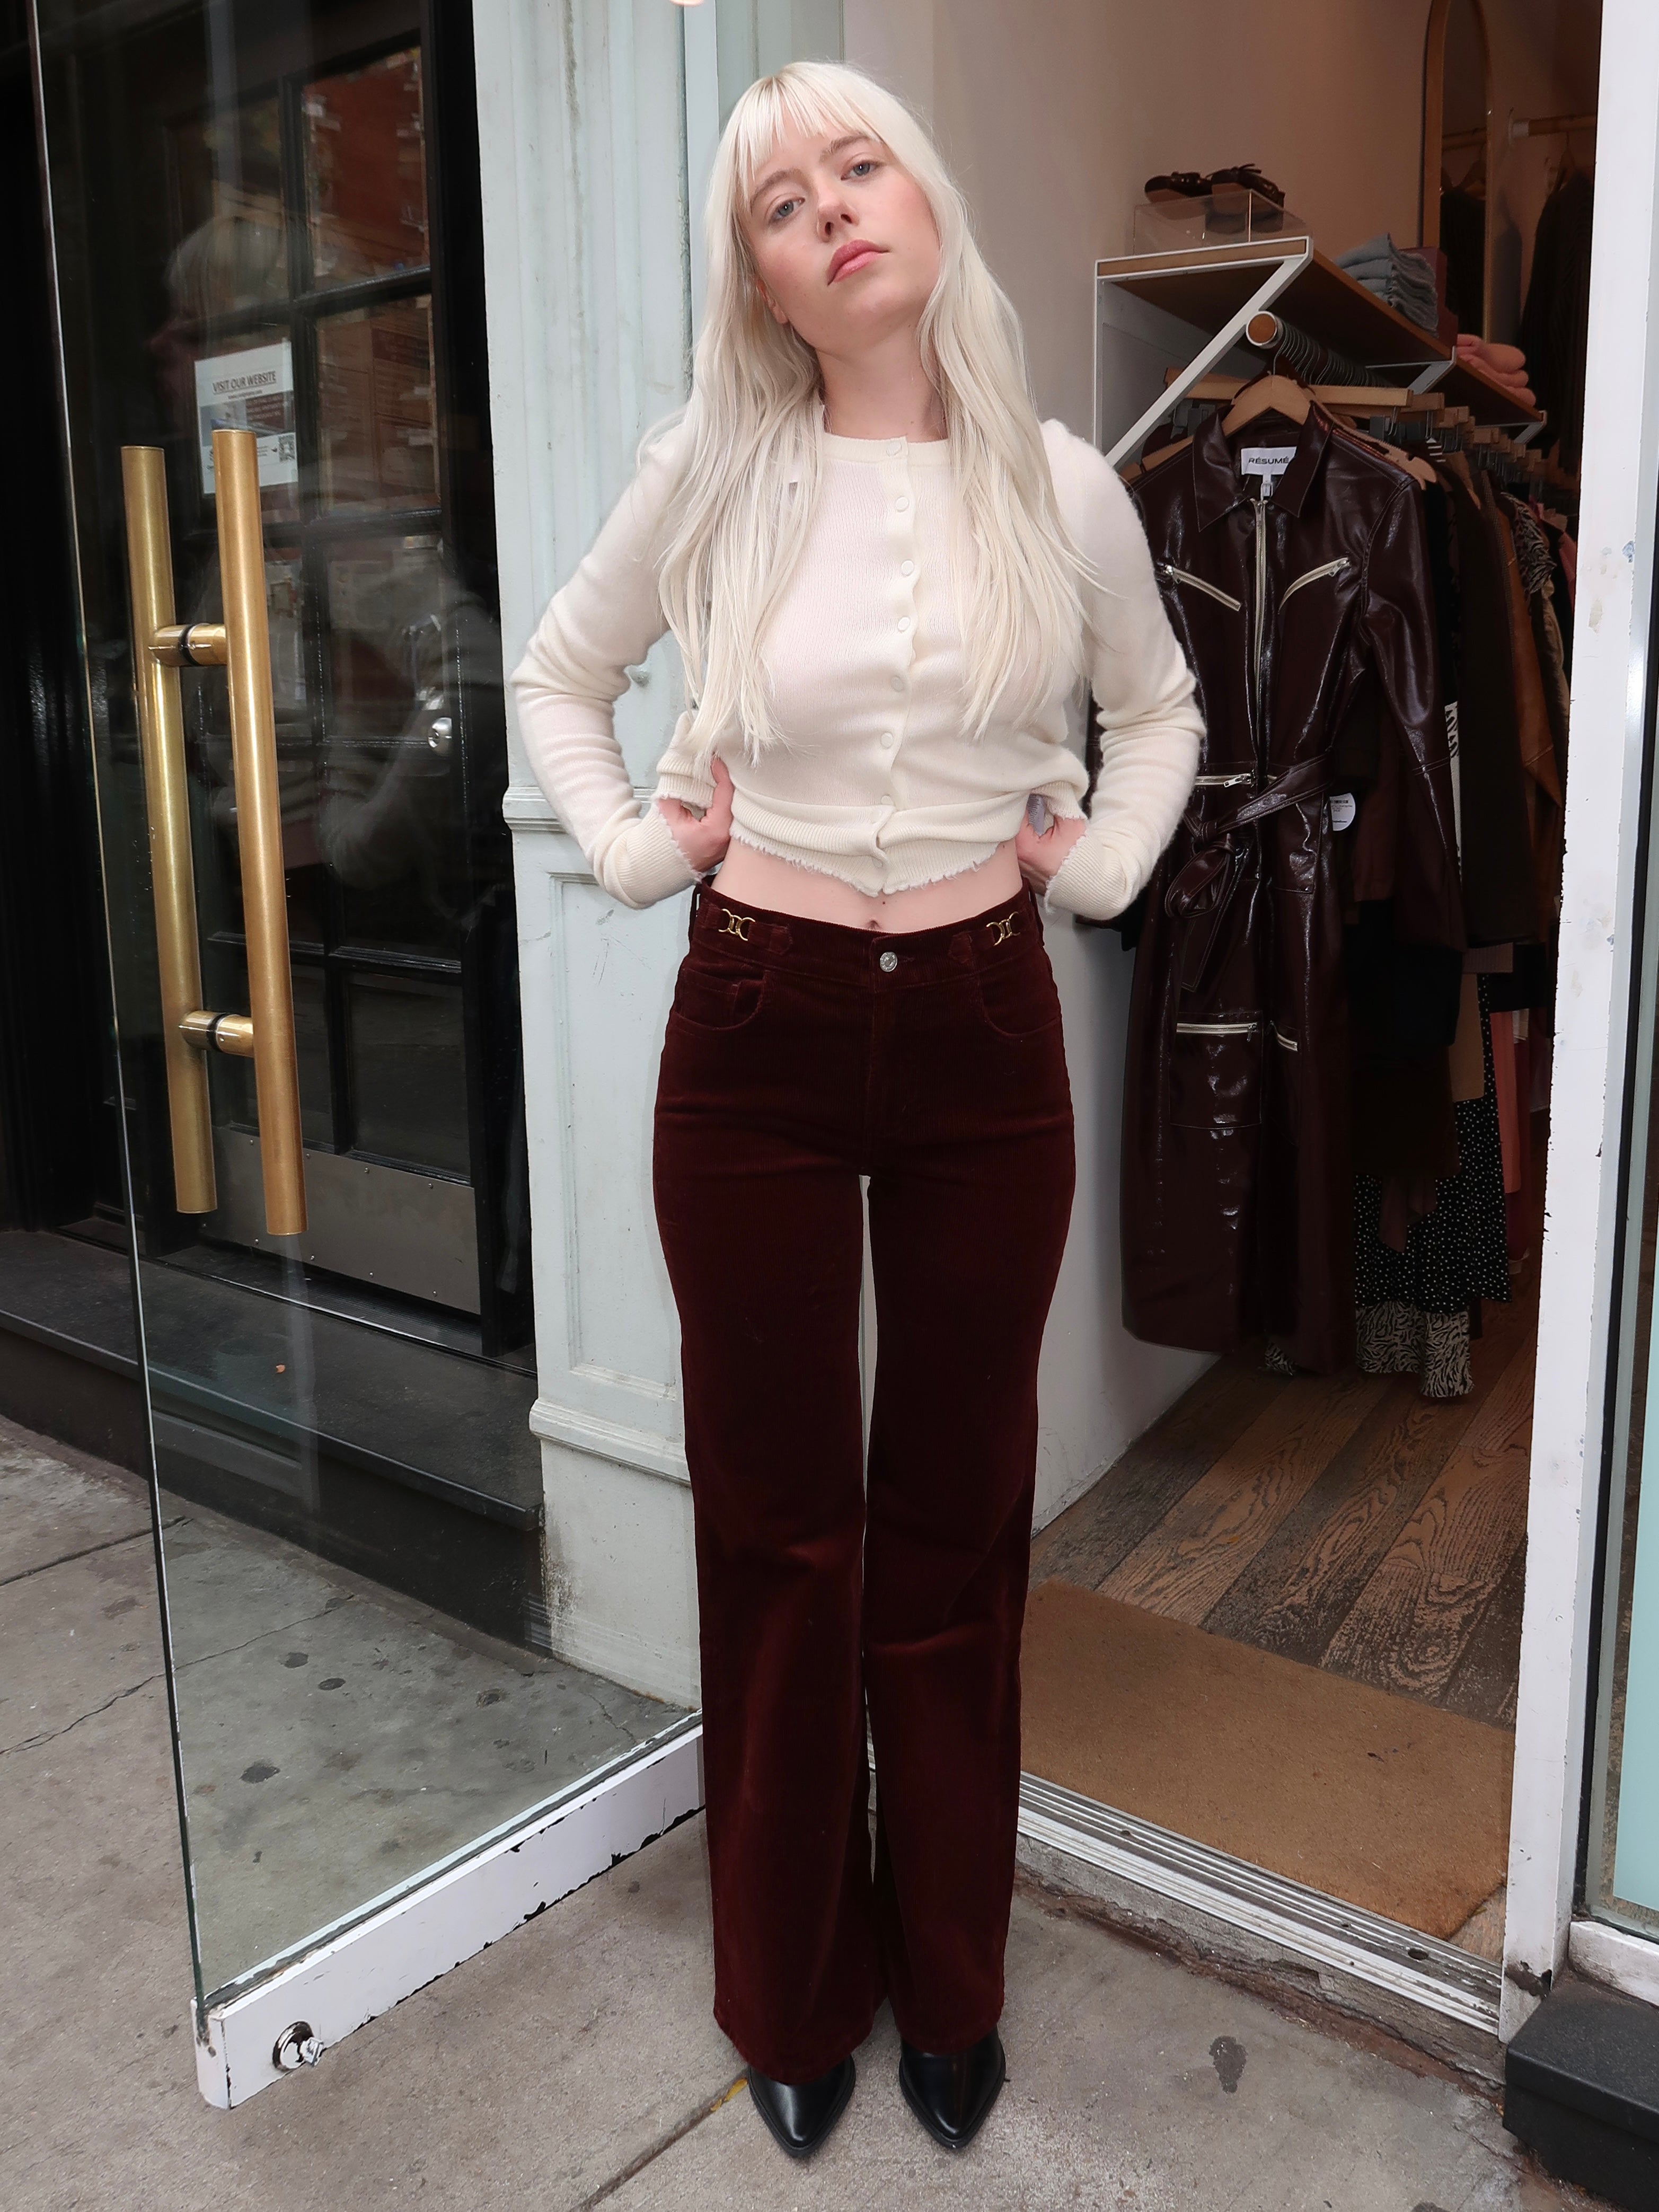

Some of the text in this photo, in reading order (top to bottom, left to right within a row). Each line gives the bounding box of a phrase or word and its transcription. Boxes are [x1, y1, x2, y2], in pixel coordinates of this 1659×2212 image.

[213, 371, 276, 392] VISIT OUR WEBSITE
[1248, 456, 1289, 464] RÉSUMÉ
